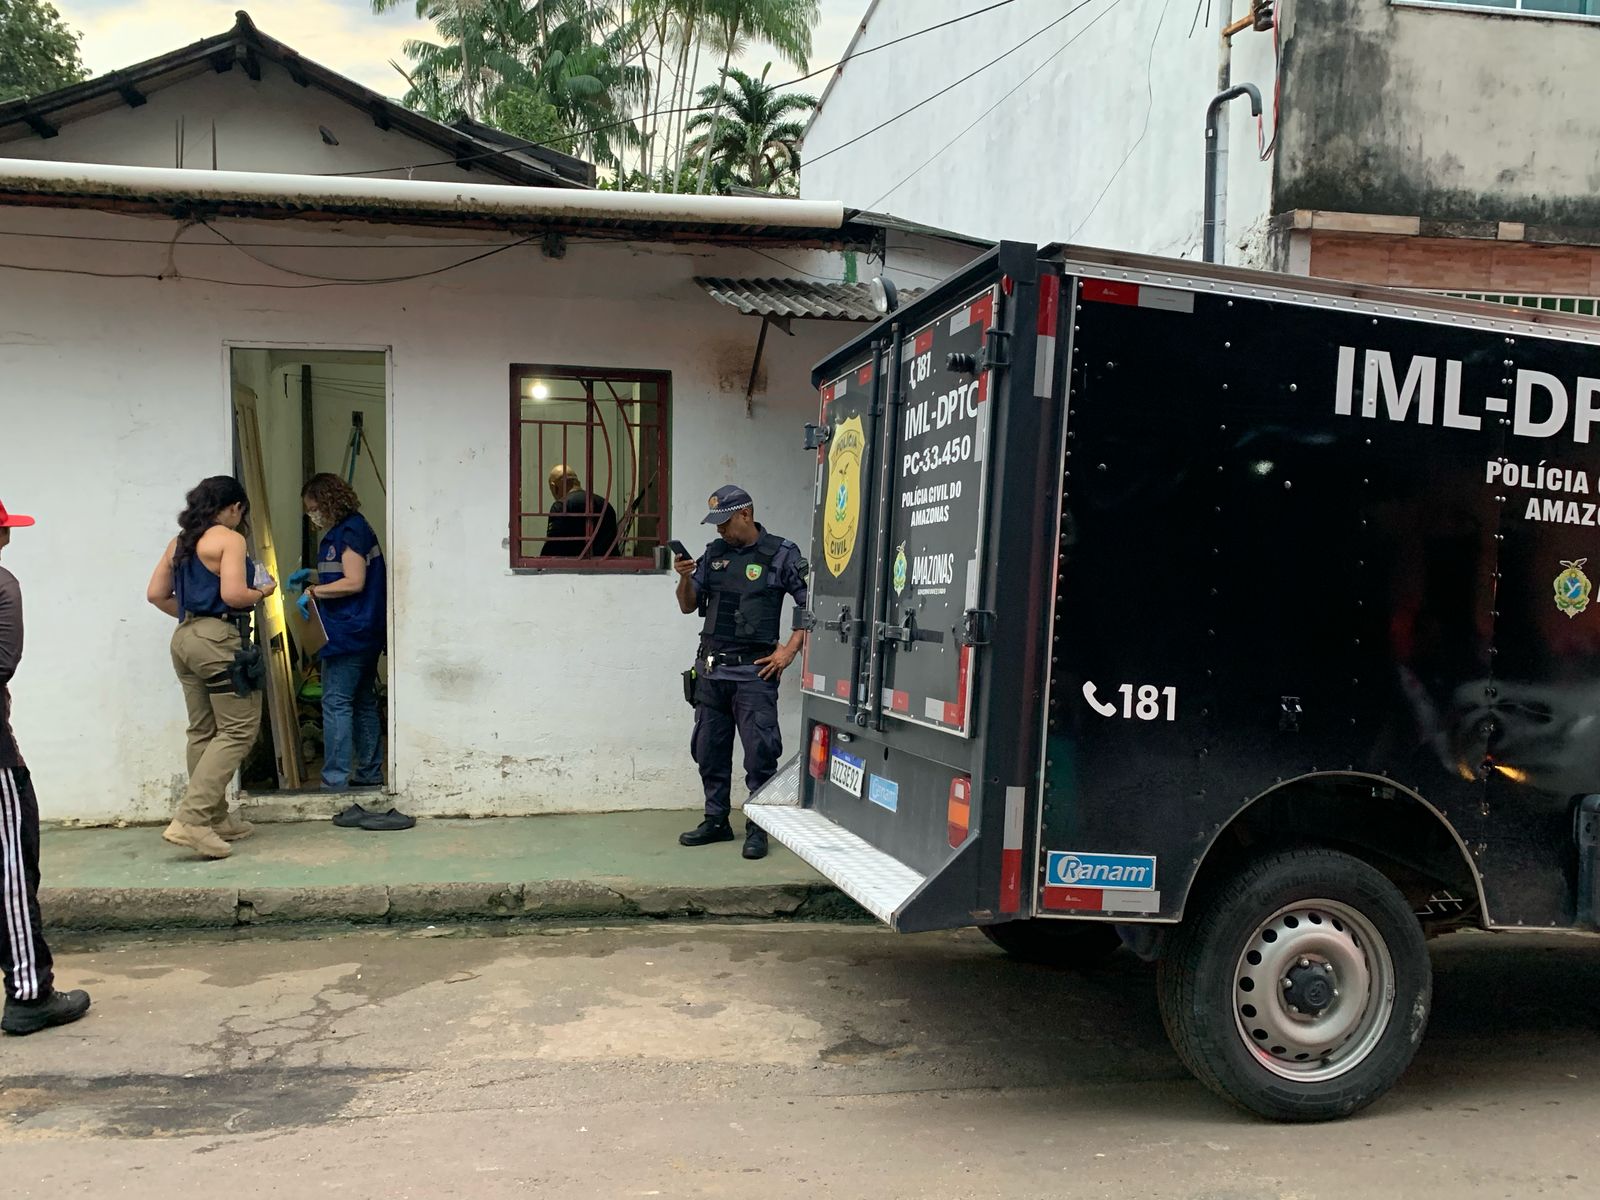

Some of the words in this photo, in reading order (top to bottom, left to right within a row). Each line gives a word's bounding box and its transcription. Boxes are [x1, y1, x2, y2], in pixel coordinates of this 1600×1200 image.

[917, 351, 931, 382] 181
[904, 380, 979, 441] IML-DPTC
[903, 434, 971, 477] PC-33.450
[1486, 460, 1590, 494] POLÍCIA
[901, 486, 928, 508] POLÍCIA
[928, 483, 949, 504] CIVIL
[949, 480, 962, 499] DO
[910, 504, 950, 527] AMAZONAS
[830, 539, 847, 556] CIVIL
[911, 552, 954, 585] AMAZONAS
[1118, 683, 1176, 721] 181
[1057, 855, 1149, 884] Ranam
